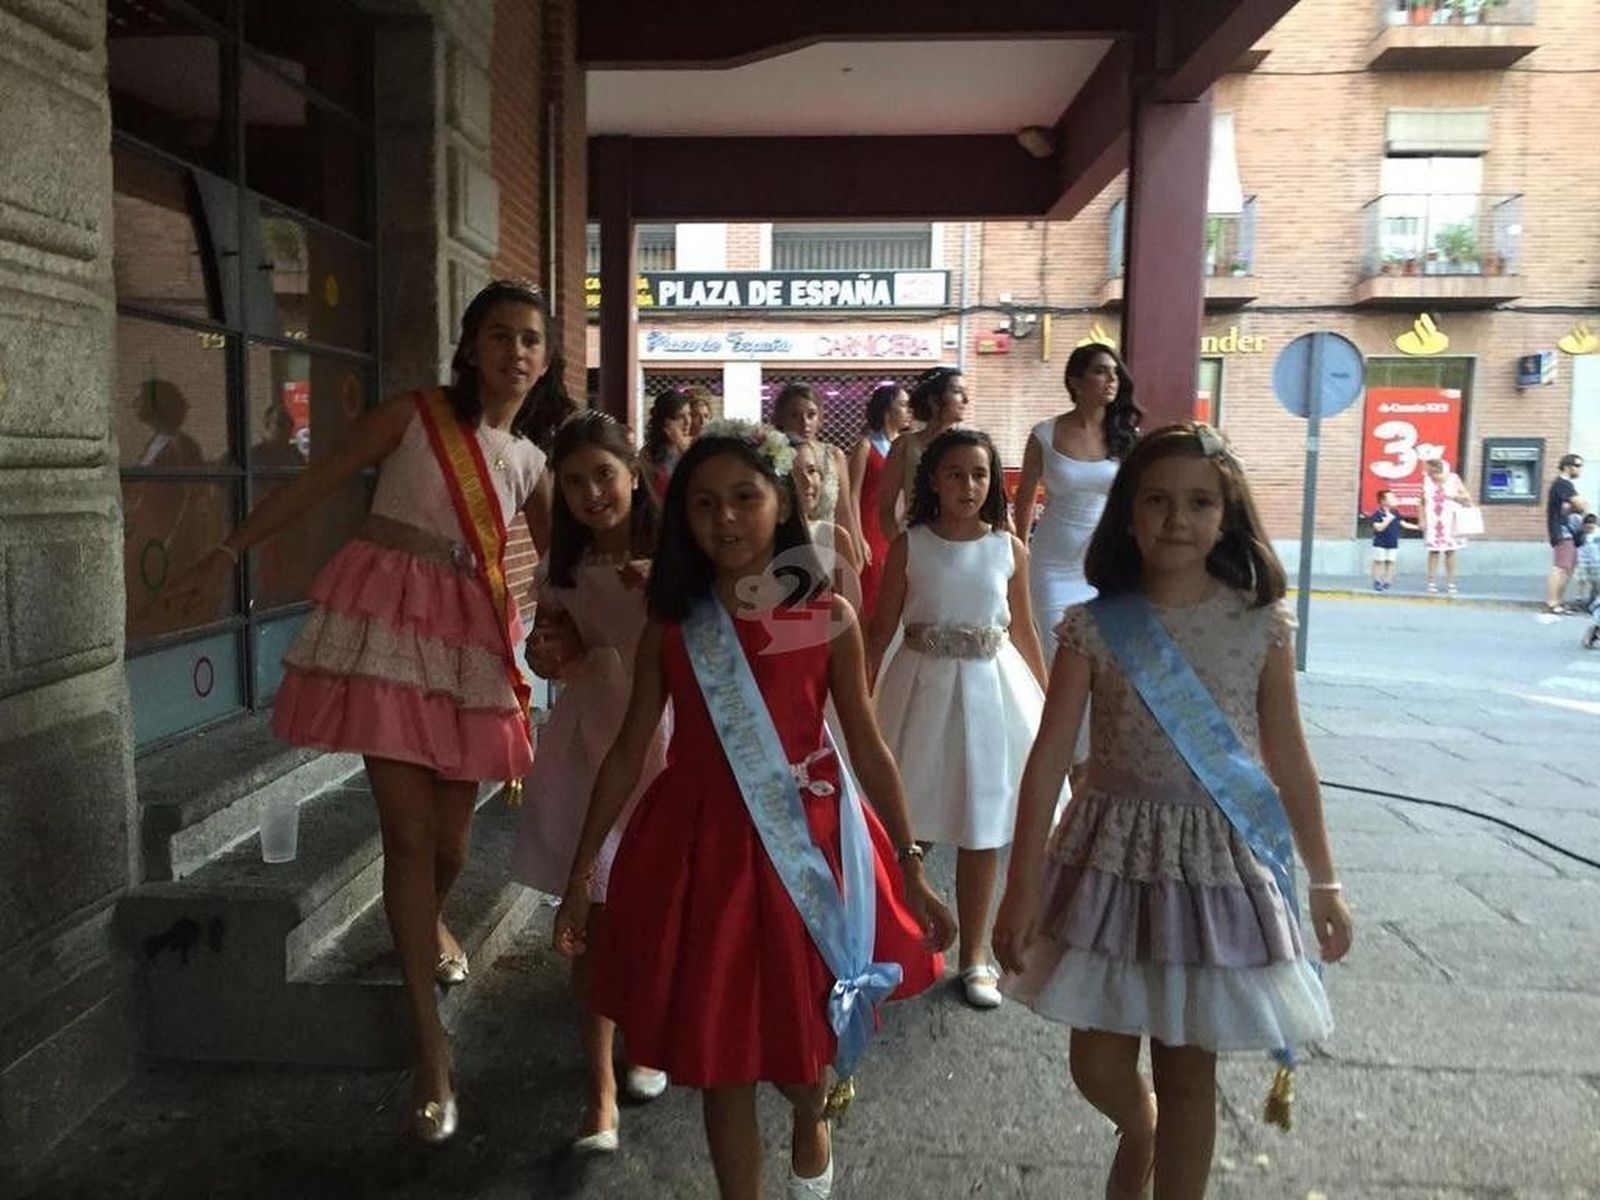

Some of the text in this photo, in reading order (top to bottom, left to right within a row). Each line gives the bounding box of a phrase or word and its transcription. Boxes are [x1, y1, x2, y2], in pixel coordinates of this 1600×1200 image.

[659, 281, 740, 305] PLAZA
[749, 281, 783, 305] DE
[790, 273, 891, 305] ESPAÑA
